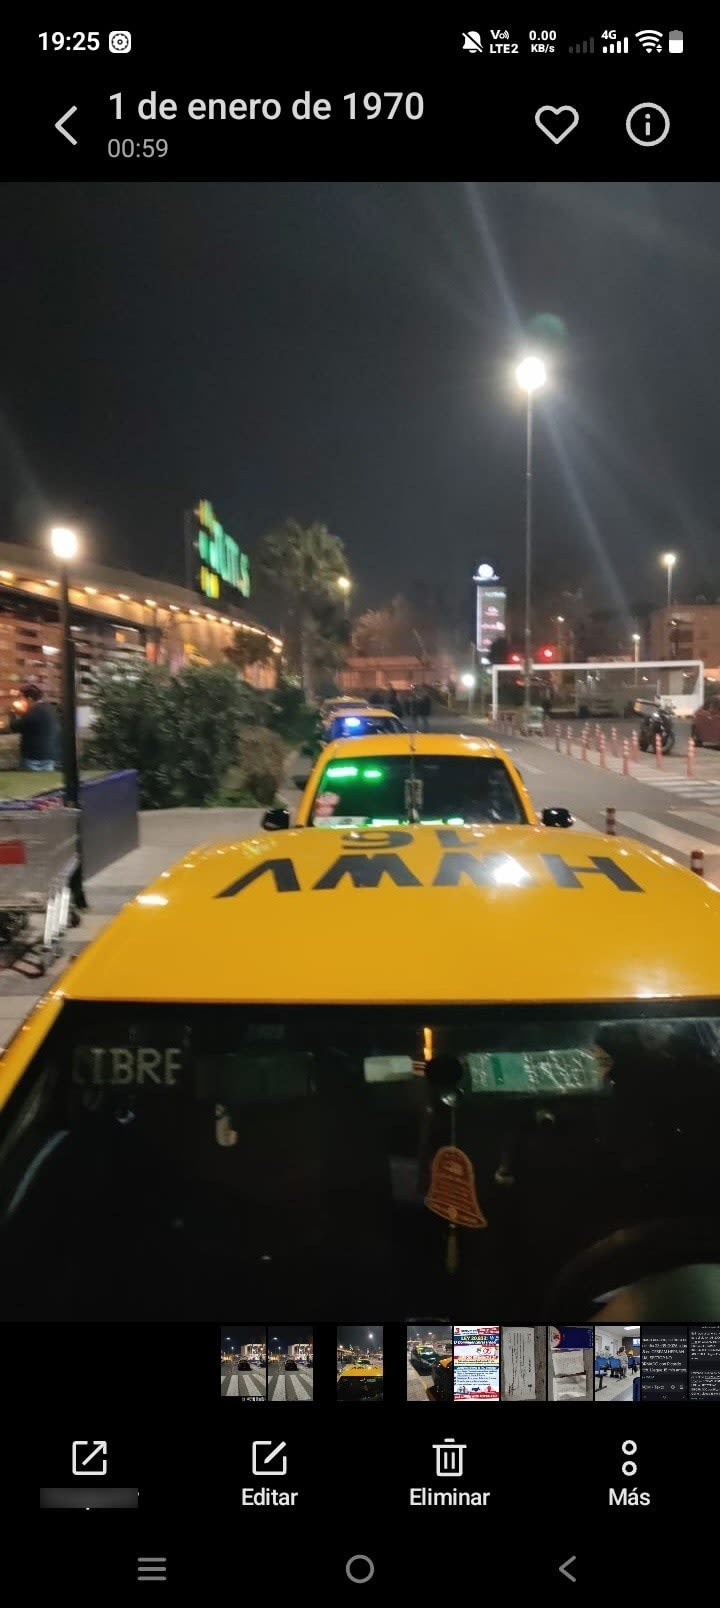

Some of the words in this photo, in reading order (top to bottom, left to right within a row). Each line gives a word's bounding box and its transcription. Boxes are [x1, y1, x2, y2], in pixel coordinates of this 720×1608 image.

[38, 31, 101, 52] 19:25
[528, 29, 557, 41] 0.00
[600, 29, 620, 41] 4G
[489, 43, 519, 54] LTE2
[530, 43, 556, 54] KB/s
[109, 91, 122, 120] 1
[137, 90, 178, 121] de
[187, 98, 282, 121] enero
[291, 90, 332, 121] de
[343, 91, 424, 121] 1970
[107, 138, 169, 159] 00:59
[340, 829, 480, 852] 16
[241, 1486, 299, 1507] Editar
[409, 1486, 491, 1507] Eliminar
[608, 1486, 651, 1507] Más
